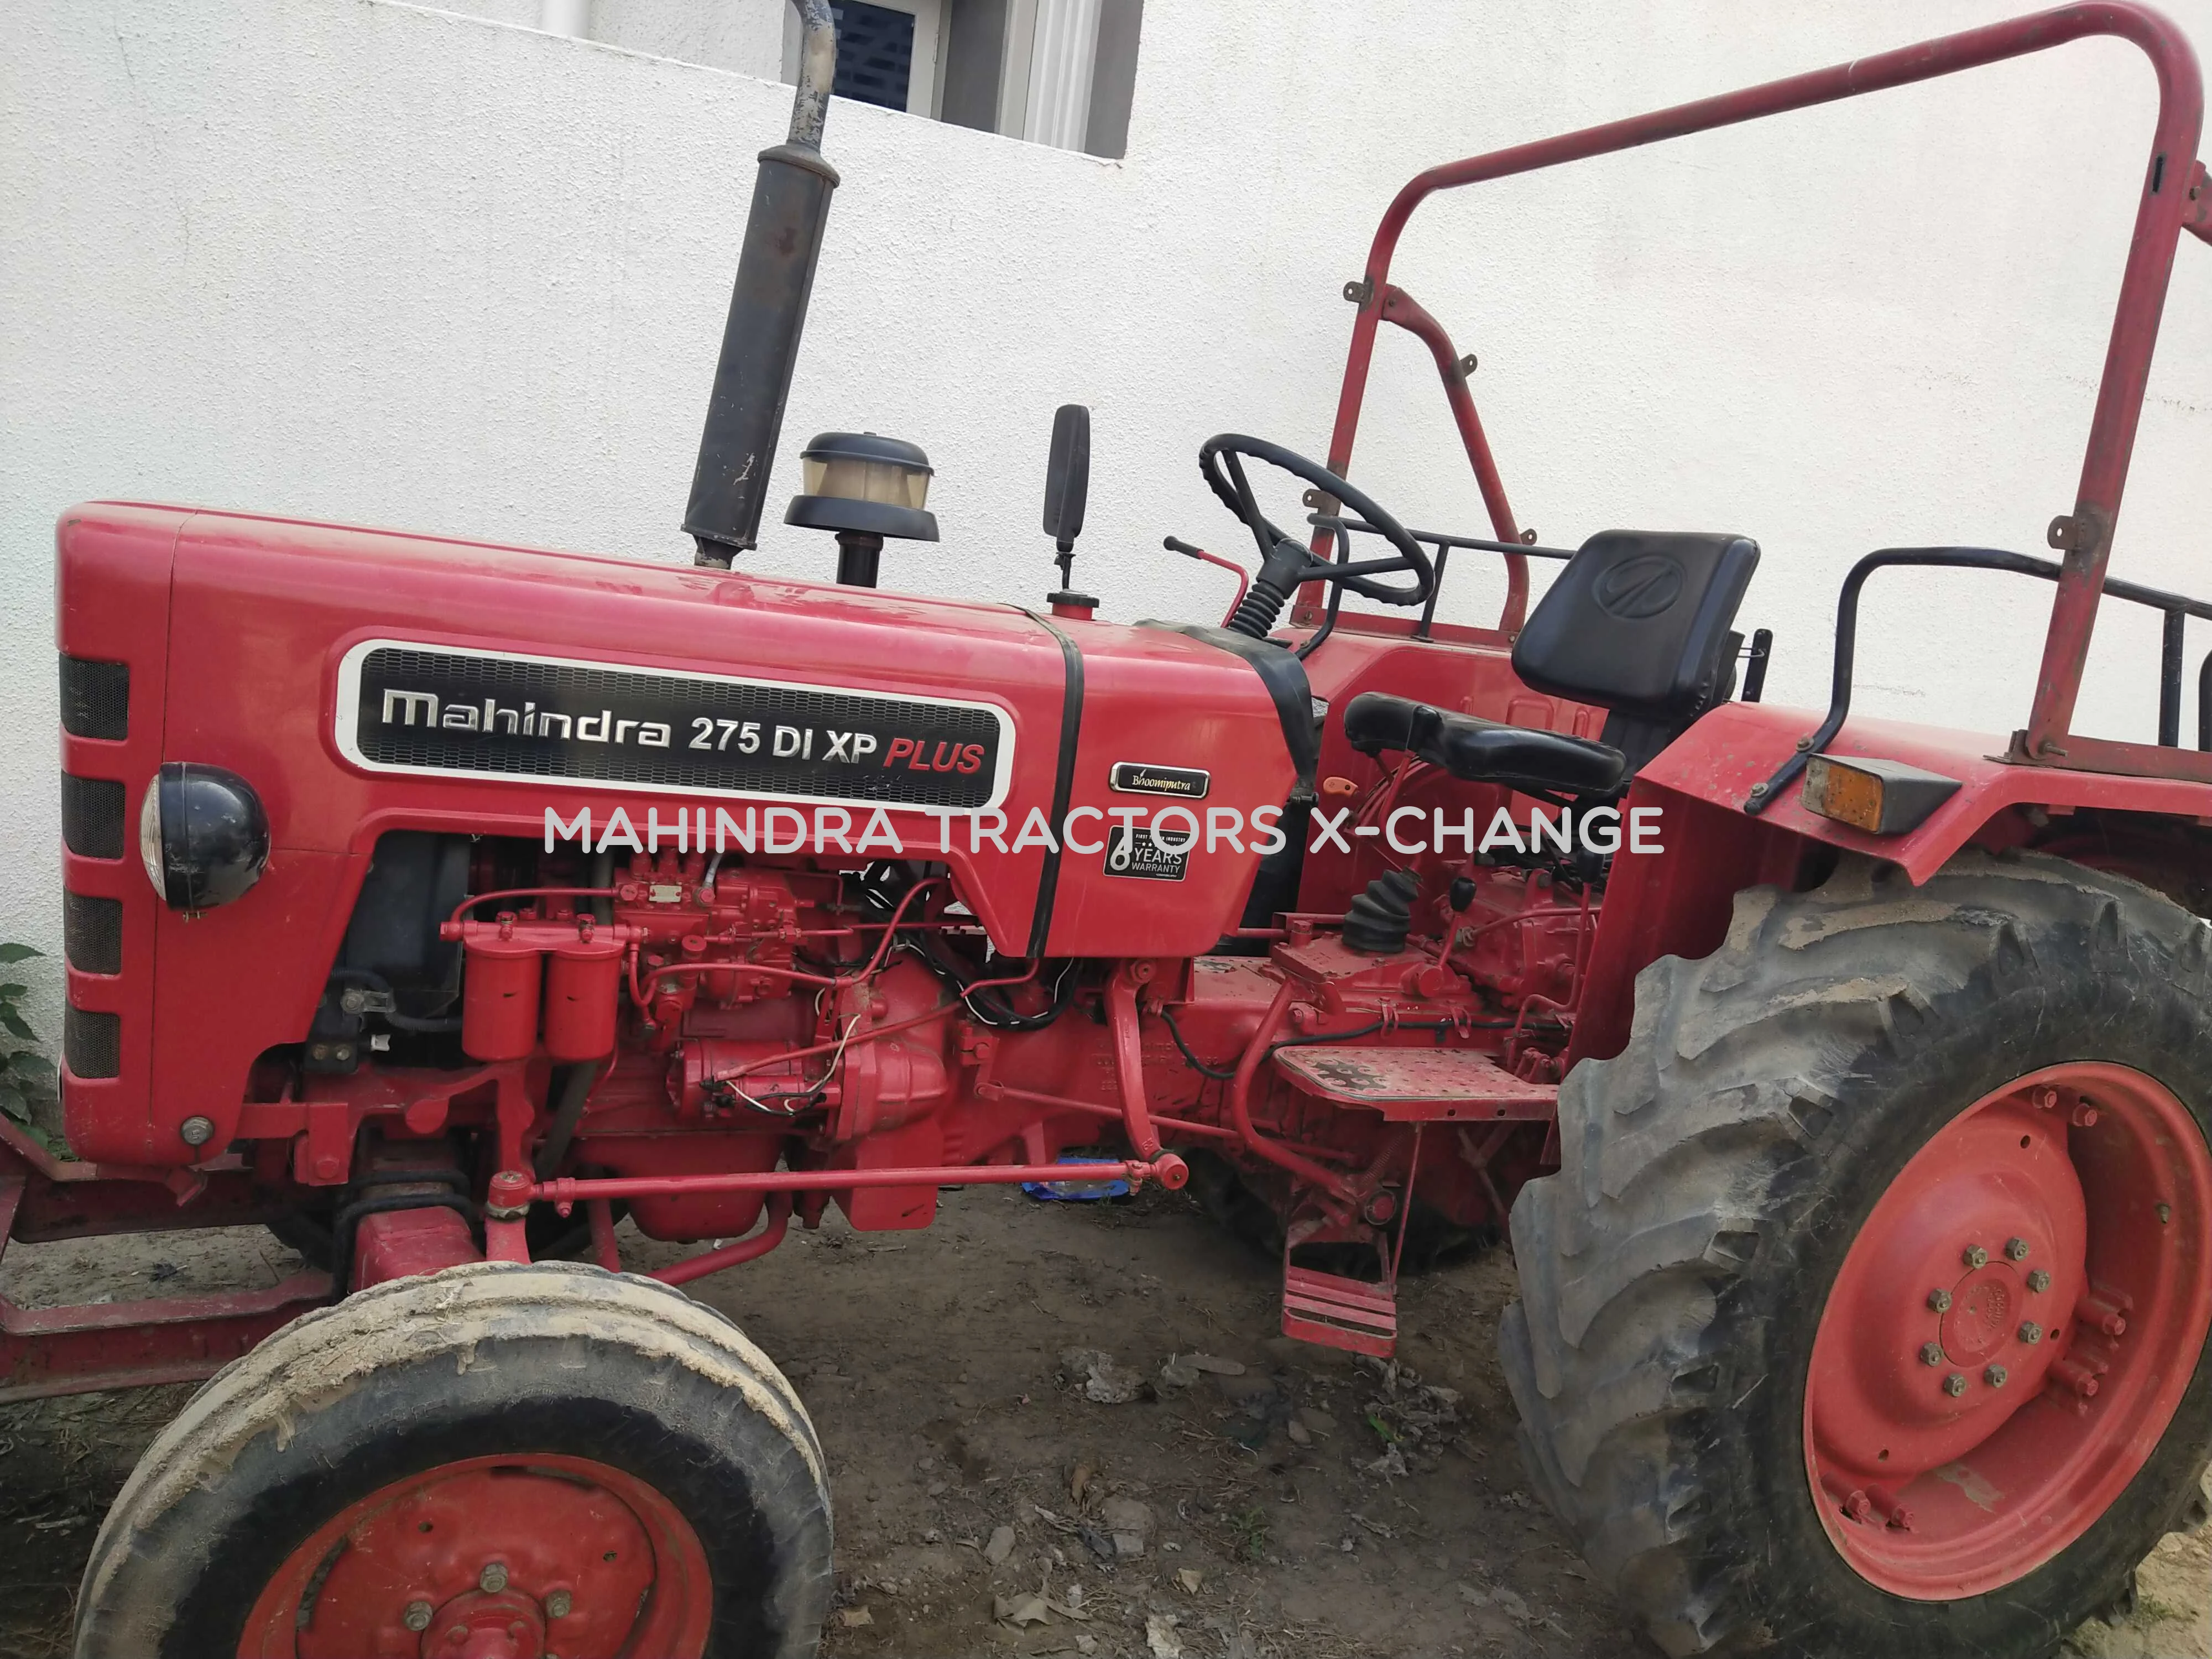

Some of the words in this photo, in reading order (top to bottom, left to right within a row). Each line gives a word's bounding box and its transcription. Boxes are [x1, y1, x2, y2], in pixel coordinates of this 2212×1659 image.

[688, 717, 761, 754] 275
[772, 725, 813, 760] DI
[821, 729, 878, 764] XP
[883, 737, 985, 774] PLUS
[1131, 768, 1191, 792] Bhoomiputra
[1110, 836, 1130, 871] 6
[1134, 847, 1182, 864] YEARS
[1131, 862, 1181, 874] WARRANTY
